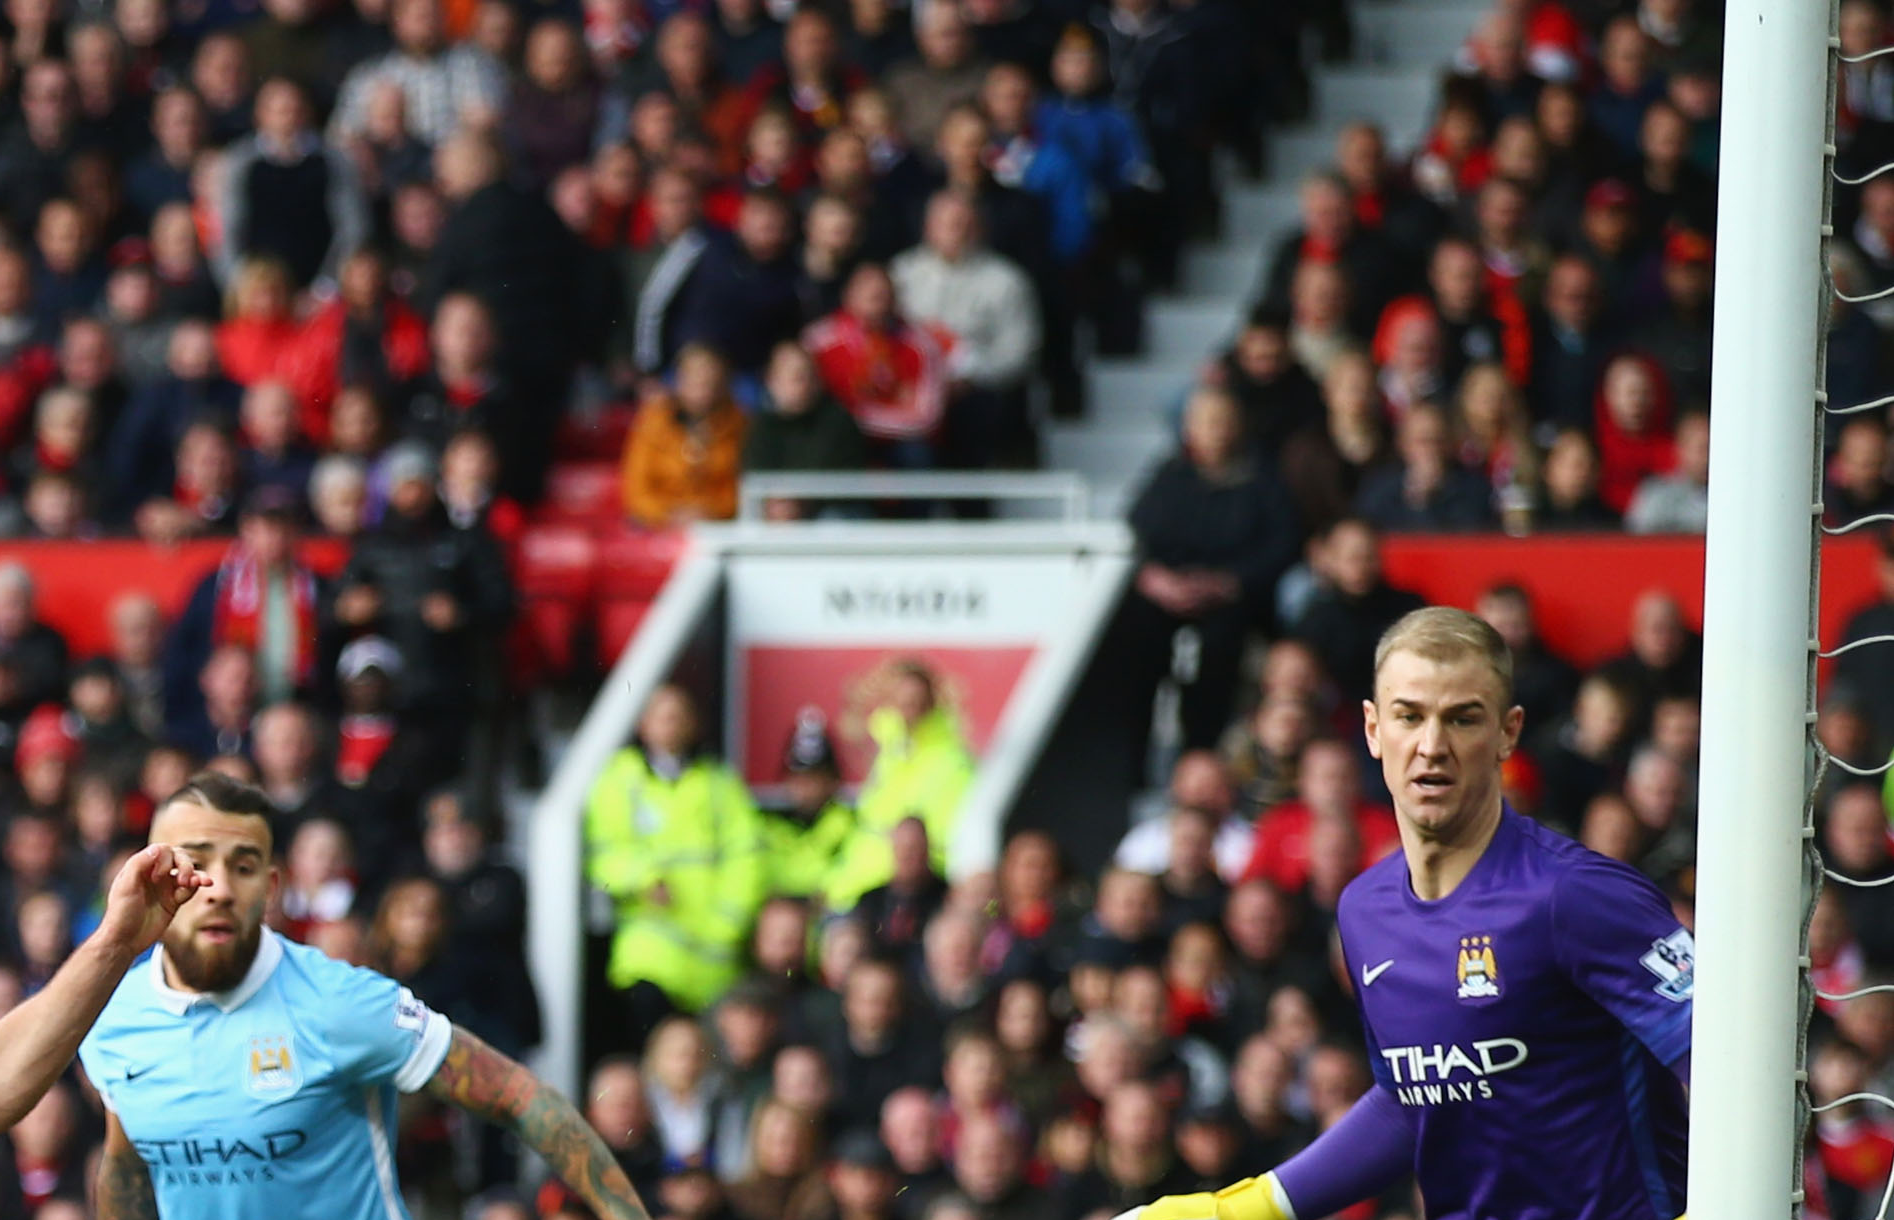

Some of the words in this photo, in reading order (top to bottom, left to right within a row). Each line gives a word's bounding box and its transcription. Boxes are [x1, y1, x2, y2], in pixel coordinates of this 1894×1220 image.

[1381, 1037, 1529, 1084] TIHAD
[1396, 1079, 1493, 1107] AIRWAYS
[134, 1128, 307, 1166] ETIHAD
[164, 1166, 275, 1186] AIRWAYS
